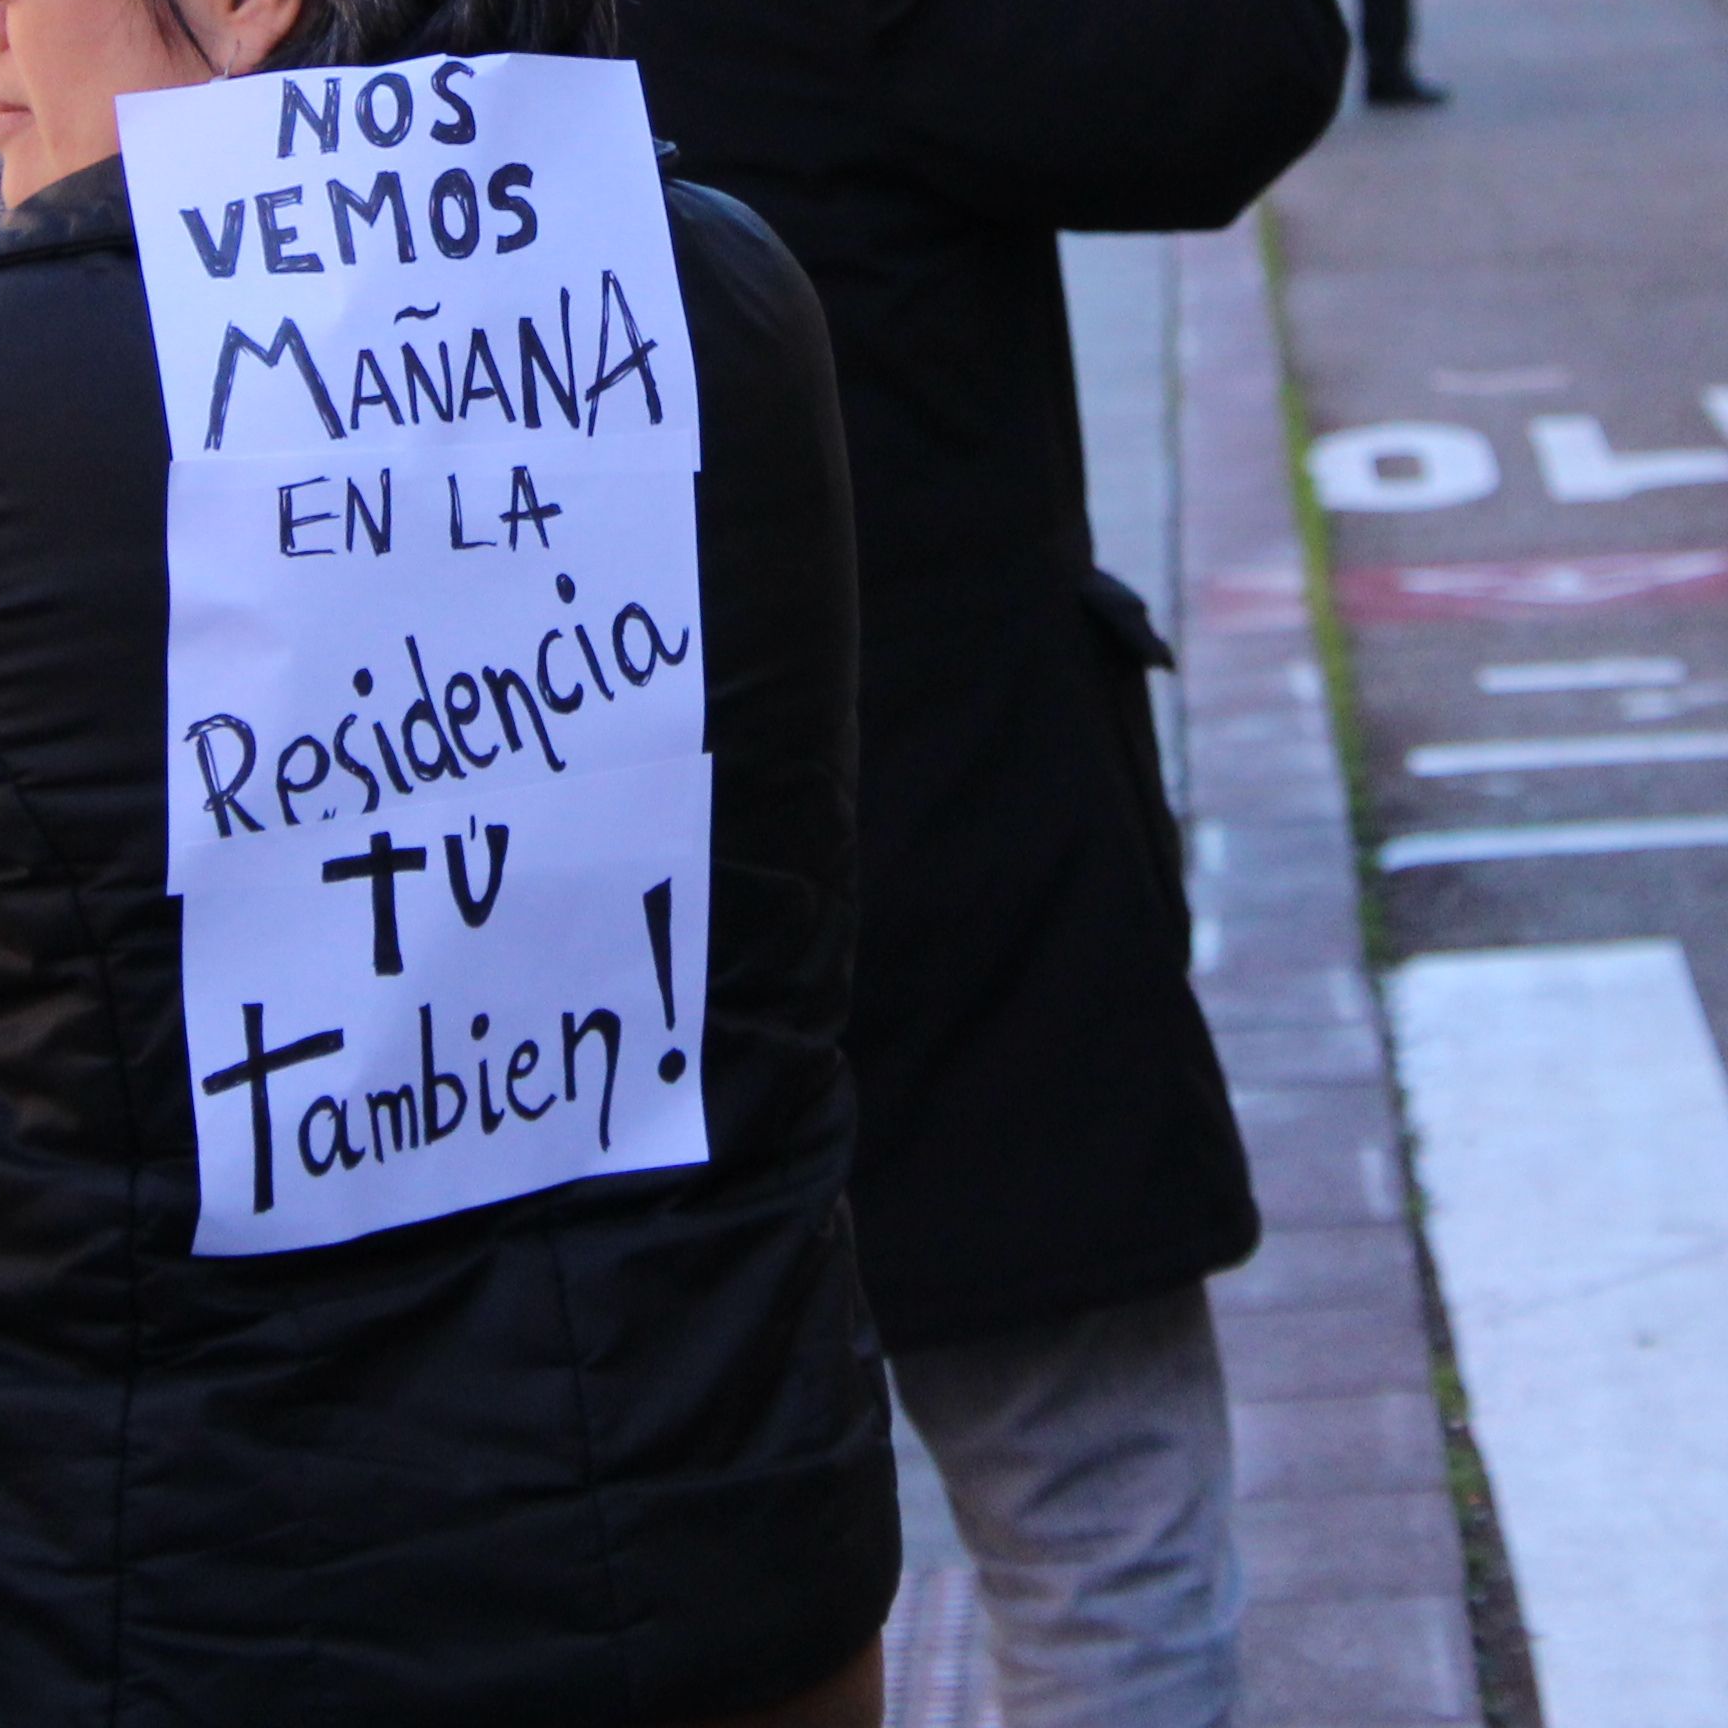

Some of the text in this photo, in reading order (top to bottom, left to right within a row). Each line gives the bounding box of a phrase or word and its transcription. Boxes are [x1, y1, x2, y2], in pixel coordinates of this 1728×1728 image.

[276, 60, 478, 159] NOS
[179, 162, 539, 278] VEMOS
[204, 270, 664, 451] MAÑANA
[277, 465, 562, 557] EN LA
[183, 572, 690, 838] Residencia
